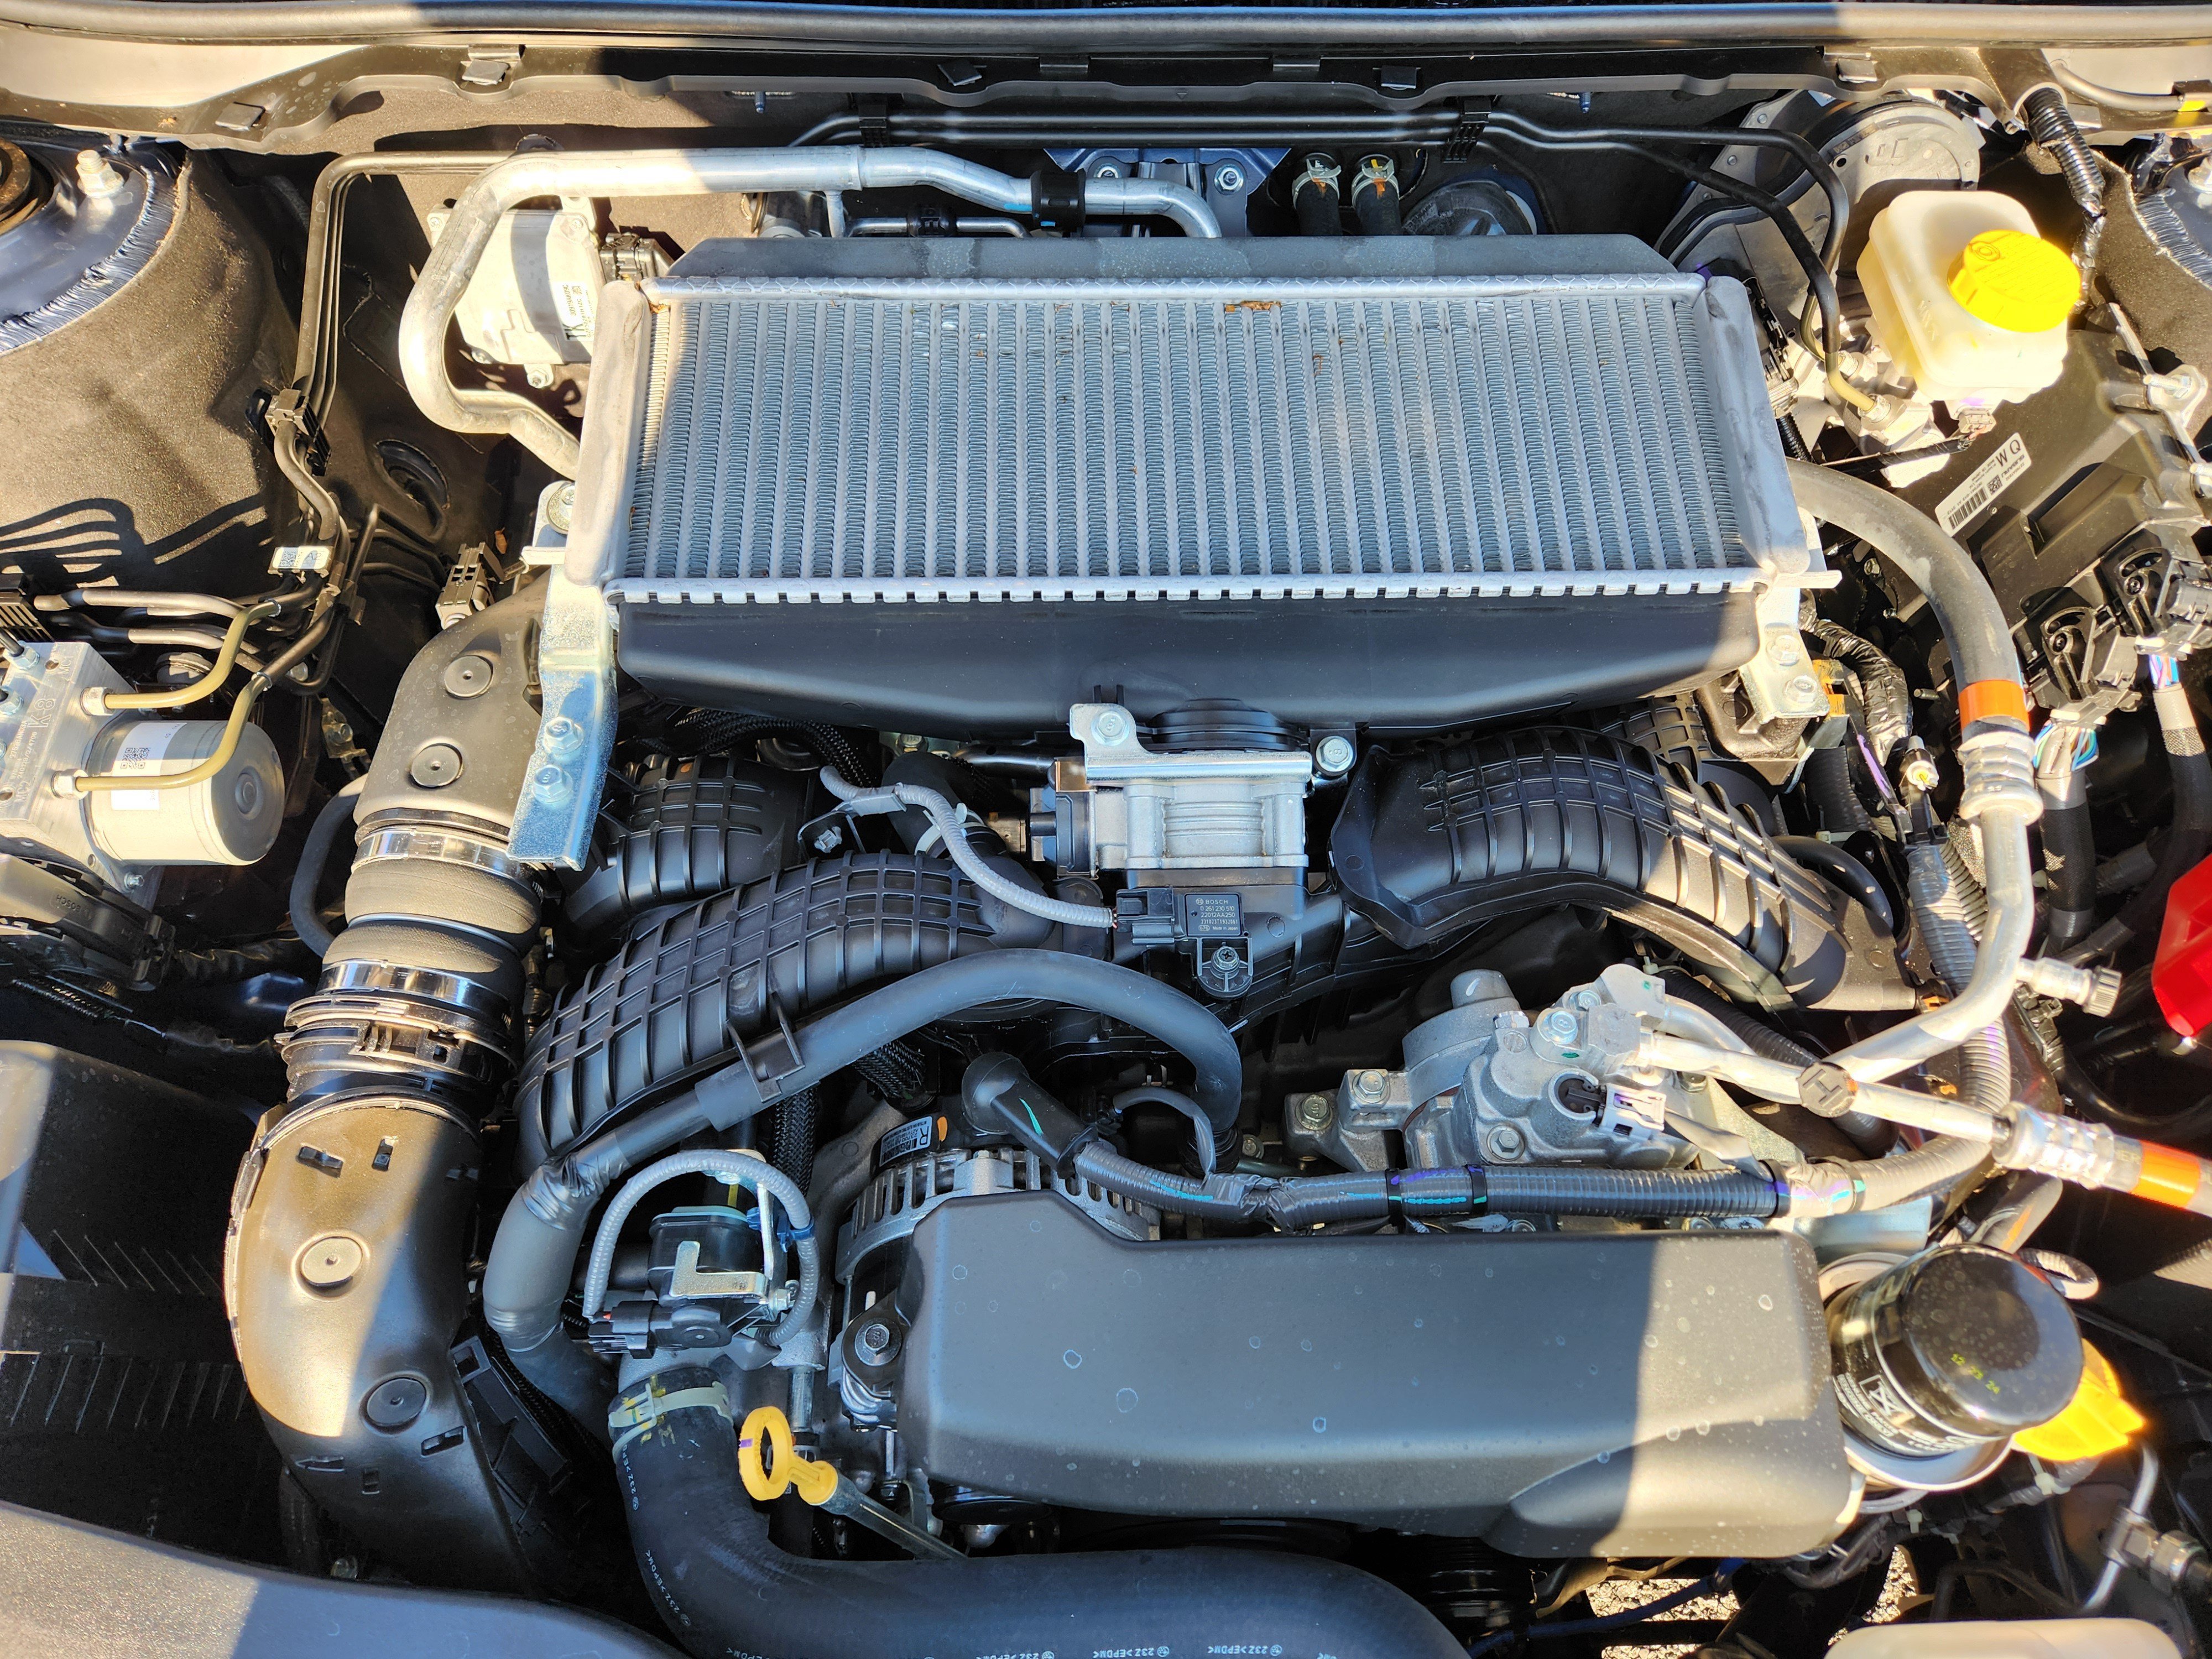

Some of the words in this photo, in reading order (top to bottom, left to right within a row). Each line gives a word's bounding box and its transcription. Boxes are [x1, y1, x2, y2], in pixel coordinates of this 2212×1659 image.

[2001, 455, 2025, 478] SUBARU
[306, 551, 322, 560] A2
[56, 894, 81, 911] BOSCH
[919, 1126, 929, 1145] R
